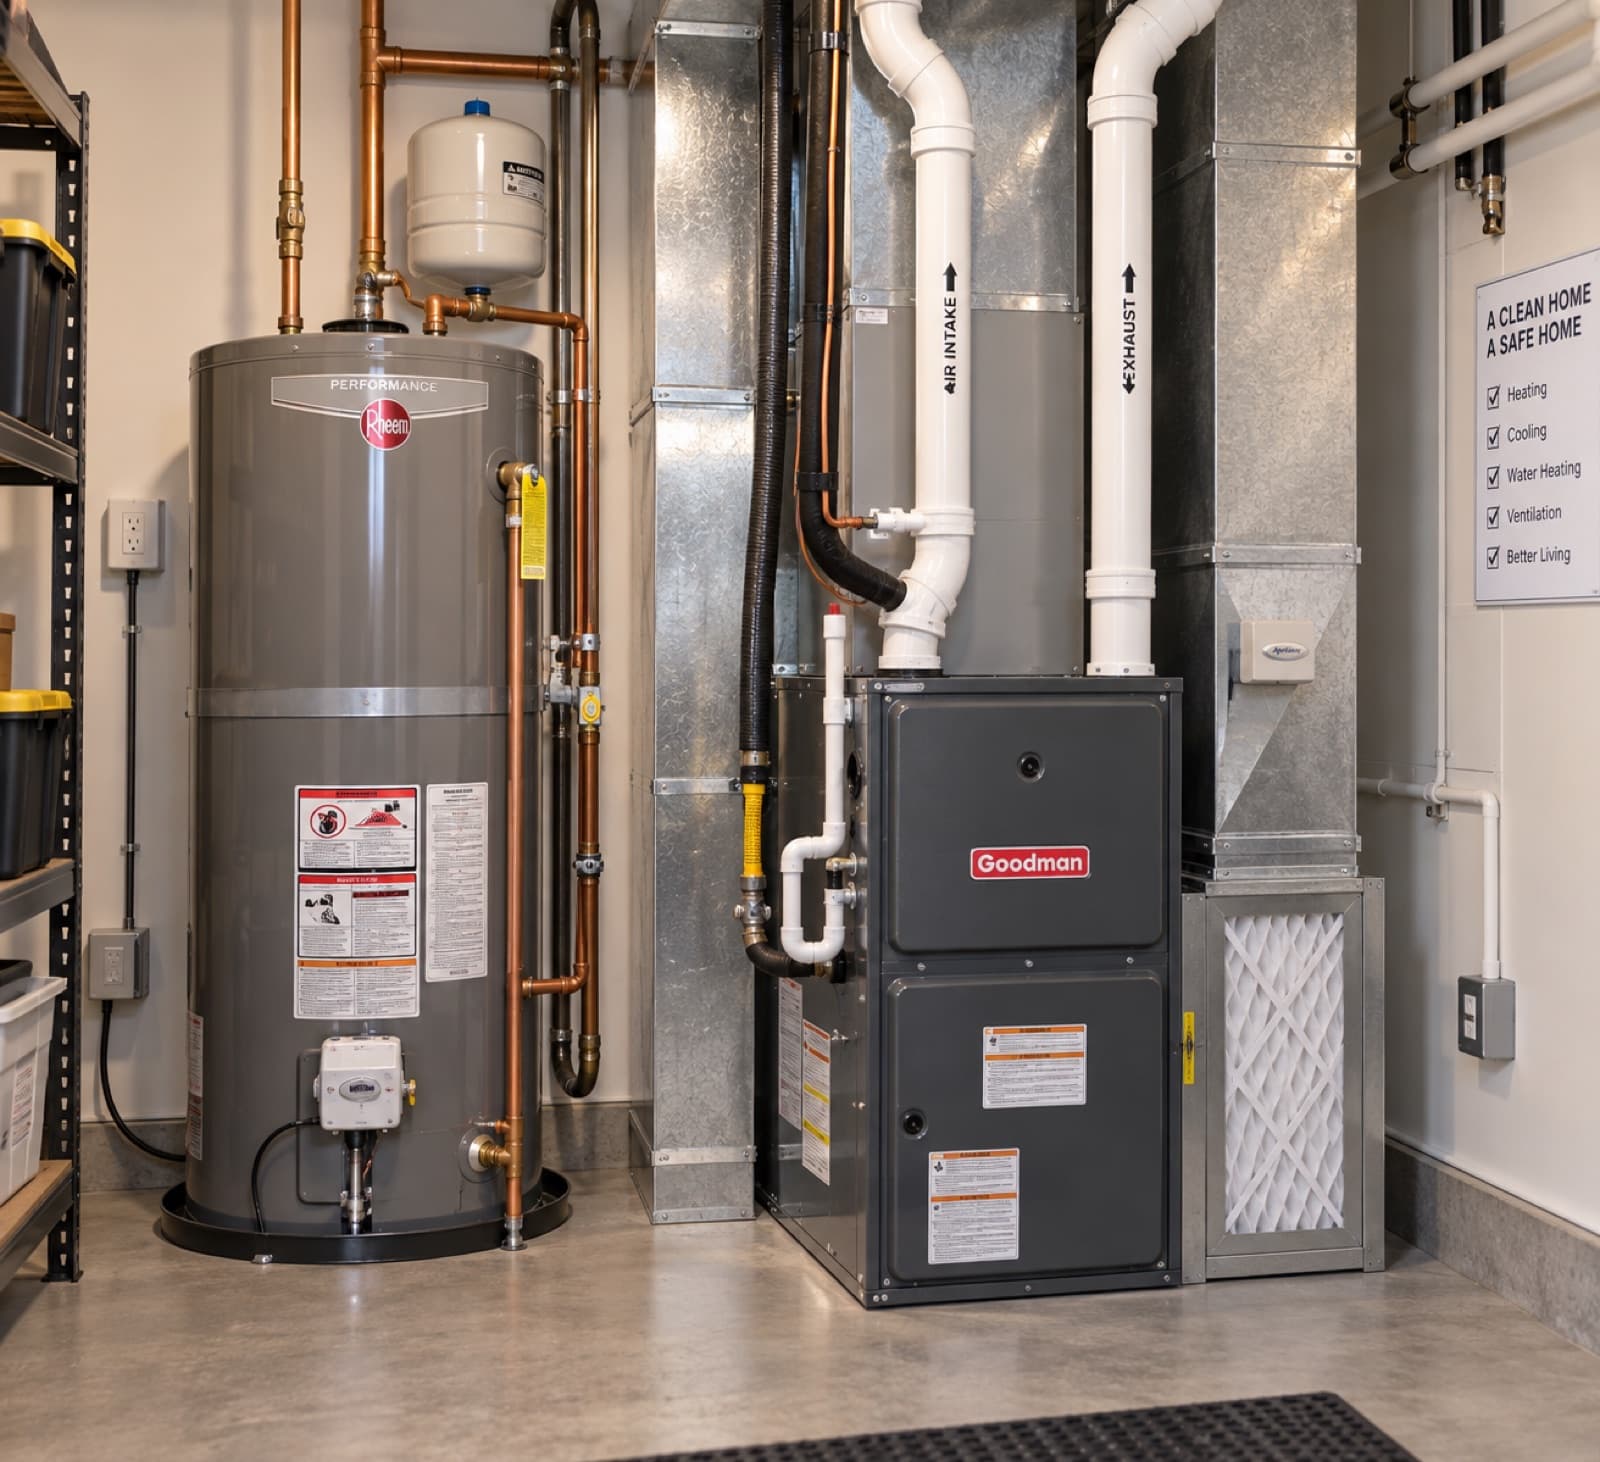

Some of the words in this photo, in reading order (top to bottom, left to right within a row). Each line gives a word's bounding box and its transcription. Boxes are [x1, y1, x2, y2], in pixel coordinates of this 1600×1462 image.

[1487, 310, 1495, 331] A
[1499, 295, 1544, 327] CLEAN
[1549, 282, 1591, 314] HOME
[944, 297, 957, 359] INTAKE
[1487, 338, 1496, 359] A
[1500, 327, 1534, 355] SAFE
[1538, 315, 1582, 346] HOME
[330, 379, 438, 393] PERFORMANCE
[1507, 381, 1548, 403] Heating
[366, 400, 408, 440] Rheem
[1507, 423, 1547, 443] Cooling
[1507, 467, 1538, 483] Water
[1540, 459, 1581, 479] Heating
[1507, 505, 1562, 523] Ventilation
[1507, 549, 1538, 564] Better
[1540, 546, 1571, 565] Living
[977, 852, 1083, 873] Goodman
